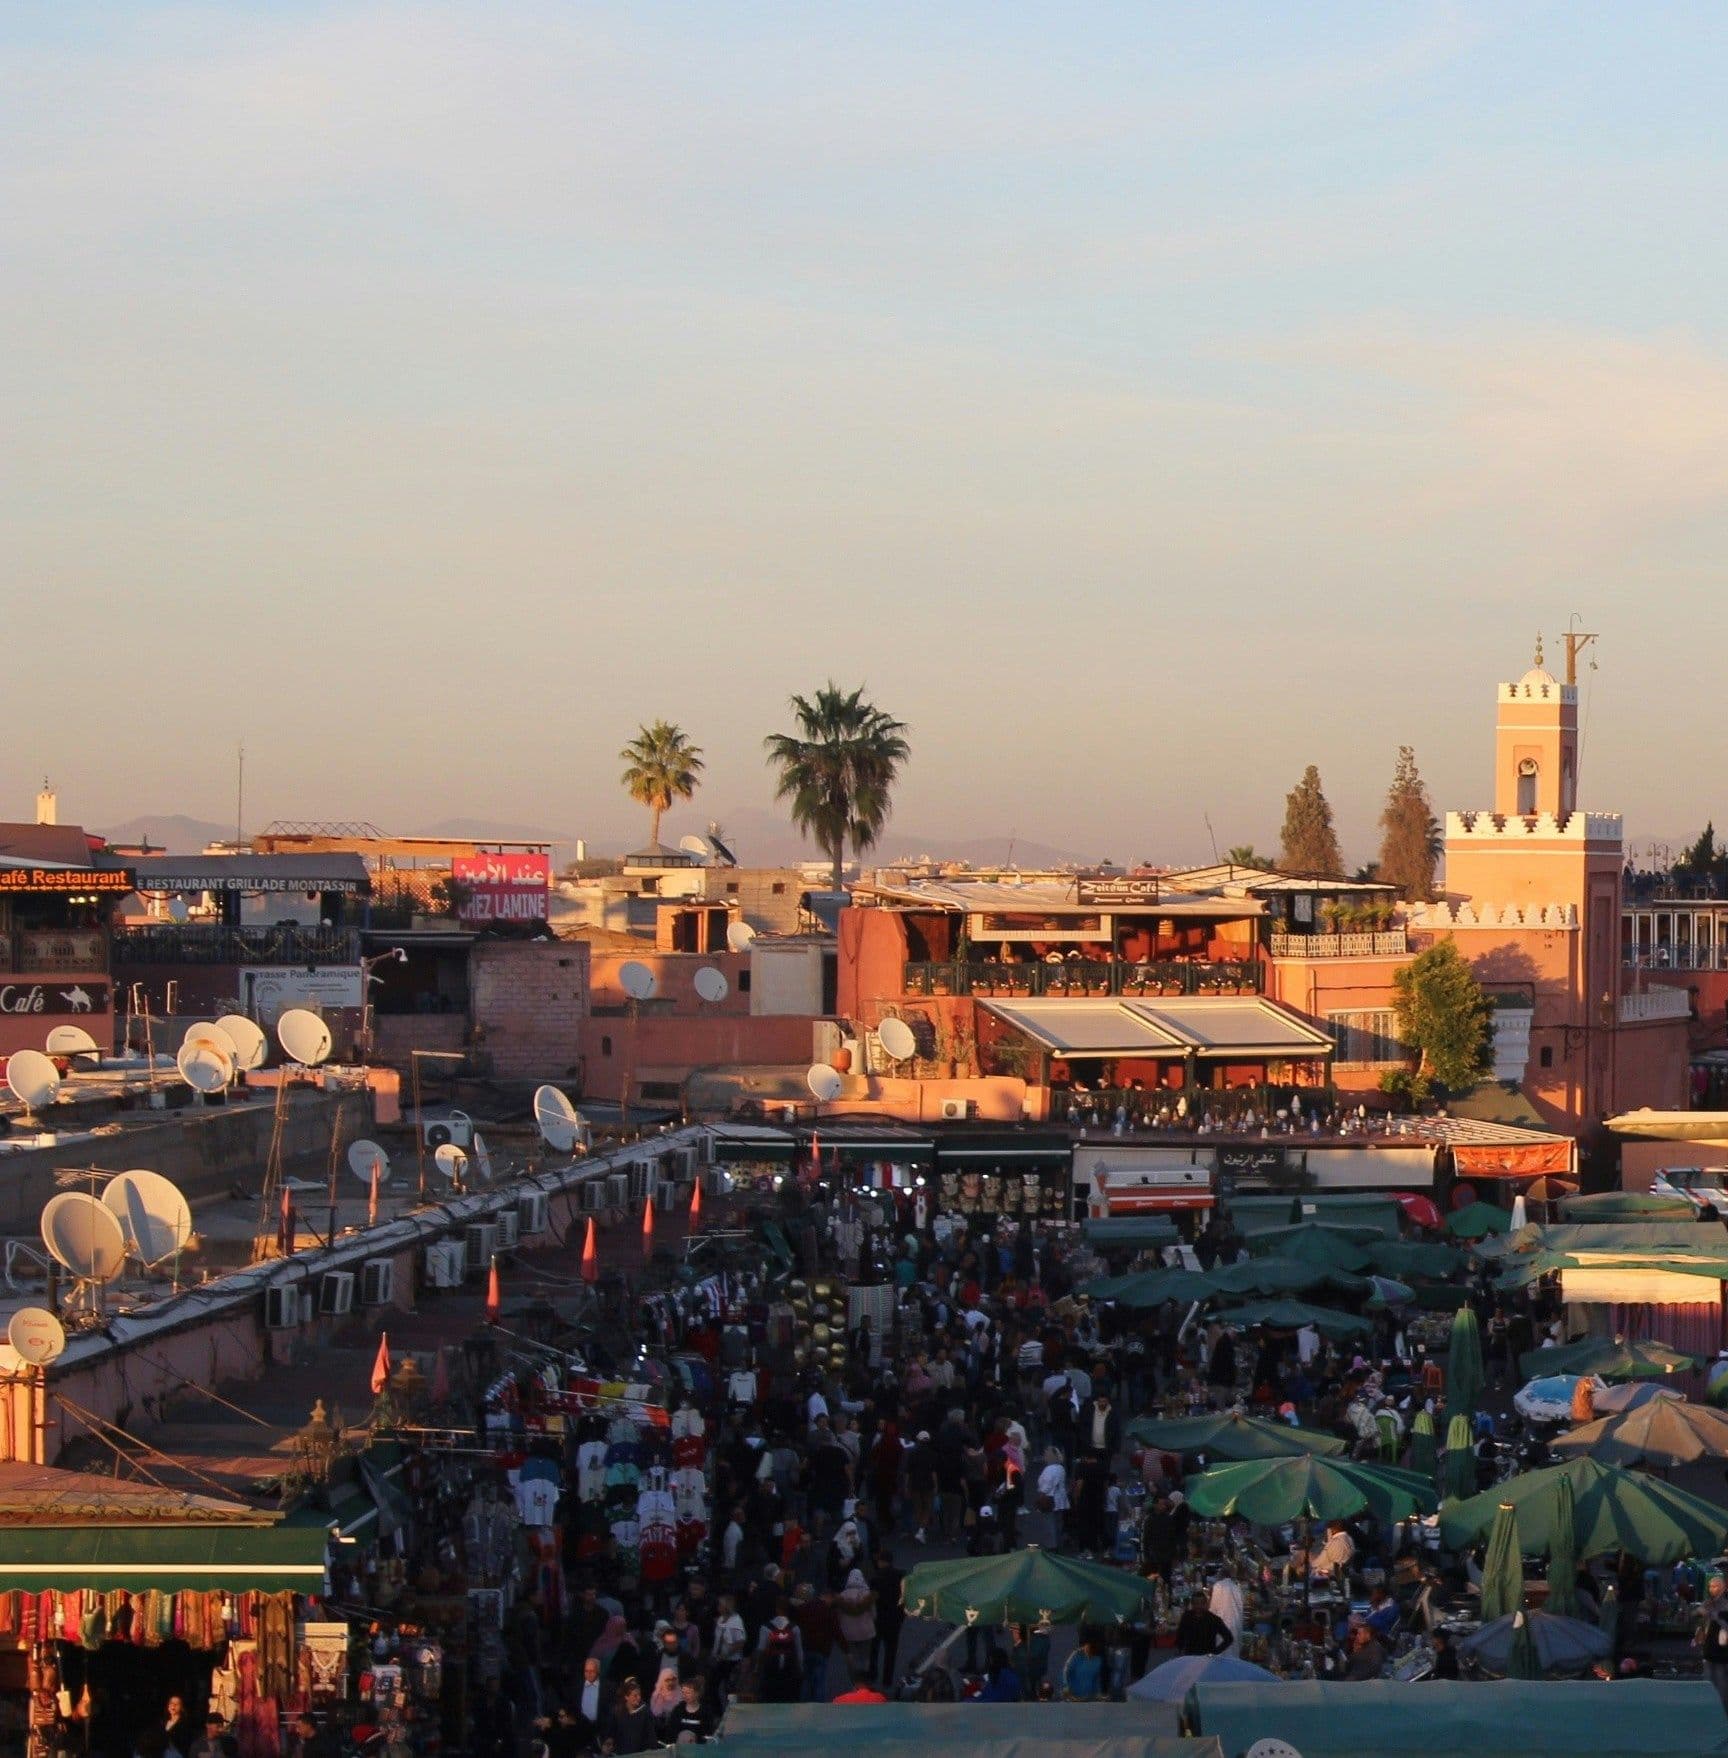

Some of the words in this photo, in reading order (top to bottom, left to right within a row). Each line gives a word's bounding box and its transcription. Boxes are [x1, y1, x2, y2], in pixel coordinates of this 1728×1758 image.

[0, 870, 28, 884] afé
[33, 870, 127, 884] Restaurant
[147, 878, 224, 890] RESTAURANT
[227, 878, 286, 890] GRILLADE
[288, 879, 357, 892] MONTASSIR
[512, 863, 544, 885] عند
[495, 893, 545, 919] LAMINE
[0, 985, 44, 1012] Café
